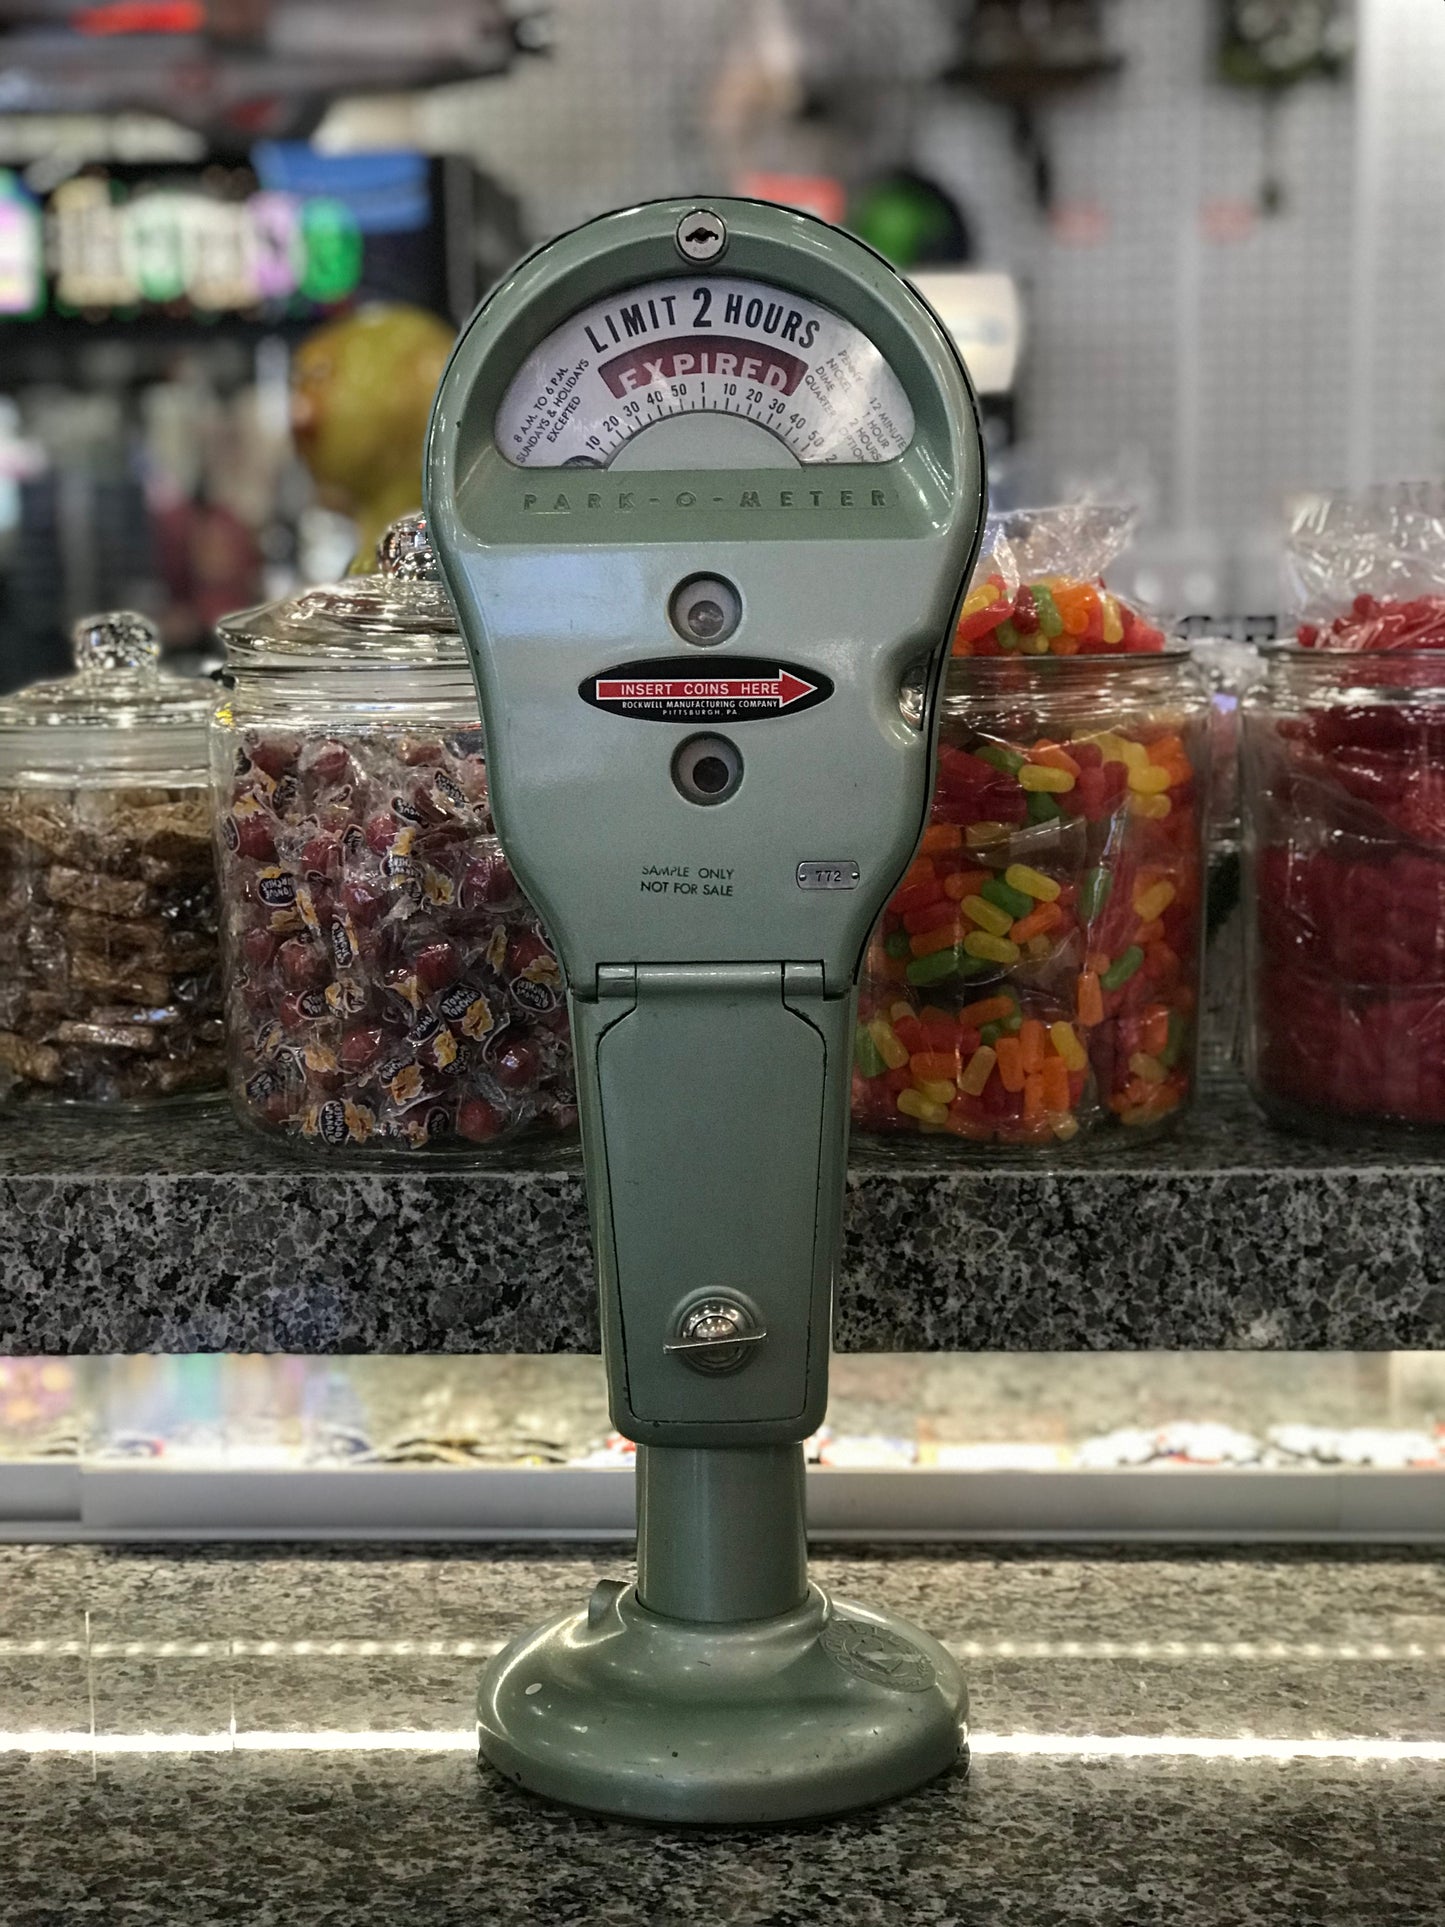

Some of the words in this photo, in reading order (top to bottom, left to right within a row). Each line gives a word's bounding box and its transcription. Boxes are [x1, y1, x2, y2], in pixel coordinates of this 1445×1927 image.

[584, 295, 677, 353] LIMIT
[692, 287, 712, 328] 2
[724, 293, 820, 349] HOURS
[618, 352, 788, 397] EXPIRED
[815, 366, 836, 392] DIME
[805, 375, 837, 418] QUARTER
[869, 397, 882, 411] 12
[513, 434, 523, 443] 8
[520, 414, 538, 435] A.M.
[533, 396, 548, 411] TO
[545, 386, 554, 396] 6
[515, 418, 551, 464] SUNDAYS
[546, 409, 557, 418] &
[553, 359, 590, 407] HOLIDAYS
[546, 396, 581, 443] EXCEPTED
[585, 435, 601, 450] 10
[603, 415, 619, 432] 20
[623, 401, 640, 417] 30
[646, 390, 663, 405] 40
[671, 383, 687, 397] 50
[724, 383, 737, 396] 10
[746, 388, 763, 403] 20
[768, 398, 786, 414] 30
[789, 413, 806, 429] 40
[808, 430, 824, 447] 50
[856, 427, 882, 461] HOURS
[867, 420, 890, 449] HOUR
[523, 490, 886, 512] PARK-O-METER
[621, 683, 673, 696] INSERT
[683, 683, 729, 695] COINS
[741, 682, 780, 695] HERE
[622, 701, 663, 709] ROCKWELL
[666, 700, 736, 709] MANUFACTURING
[738, 700, 778, 708] COMPANY
[641, 865, 690, 878] SAMPLE
[698, 867, 735, 880] ONLY
[815, 870, 841, 882] 772
[640, 881, 669, 893] NOT
[673, 882, 698, 895] FOR
[703, 884, 734, 897] SALE
